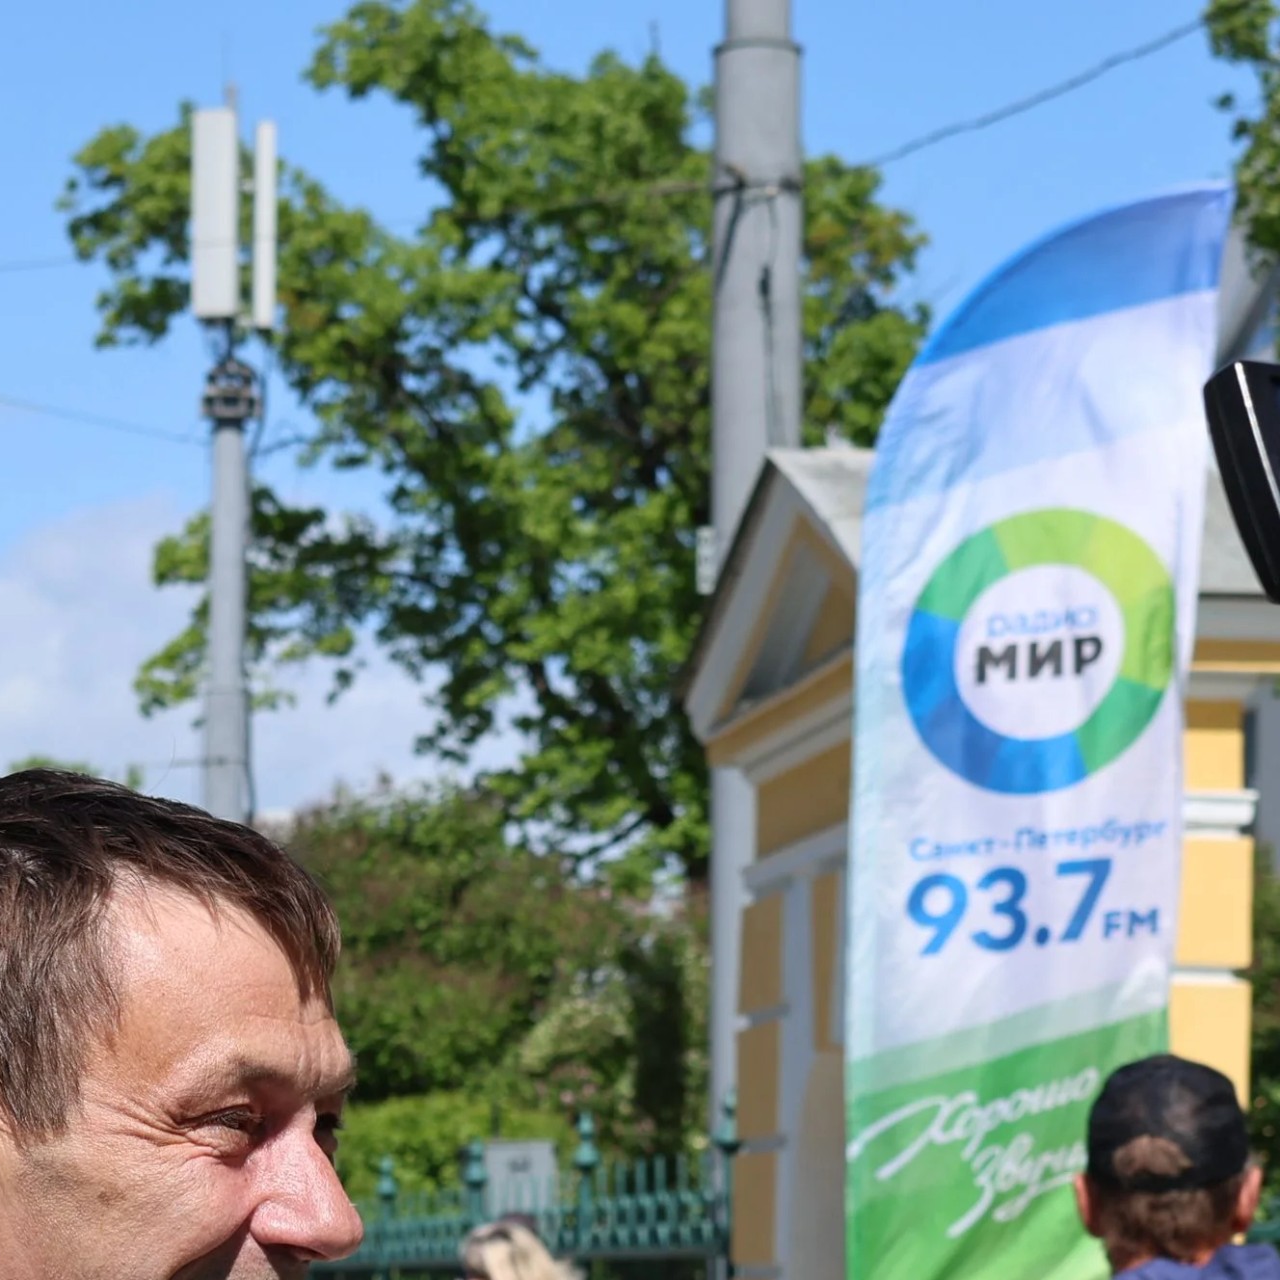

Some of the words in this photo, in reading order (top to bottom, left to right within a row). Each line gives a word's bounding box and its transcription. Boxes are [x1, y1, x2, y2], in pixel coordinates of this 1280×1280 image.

[976, 634, 1103, 685] МИР
[908, 816, 1168, 861] Санкт-Петербург
[907, 858, 1113, 956] 93.7
[1103, 908, 1159, 940] FM
[846, 1066, 1099, 1180] Хорошо
